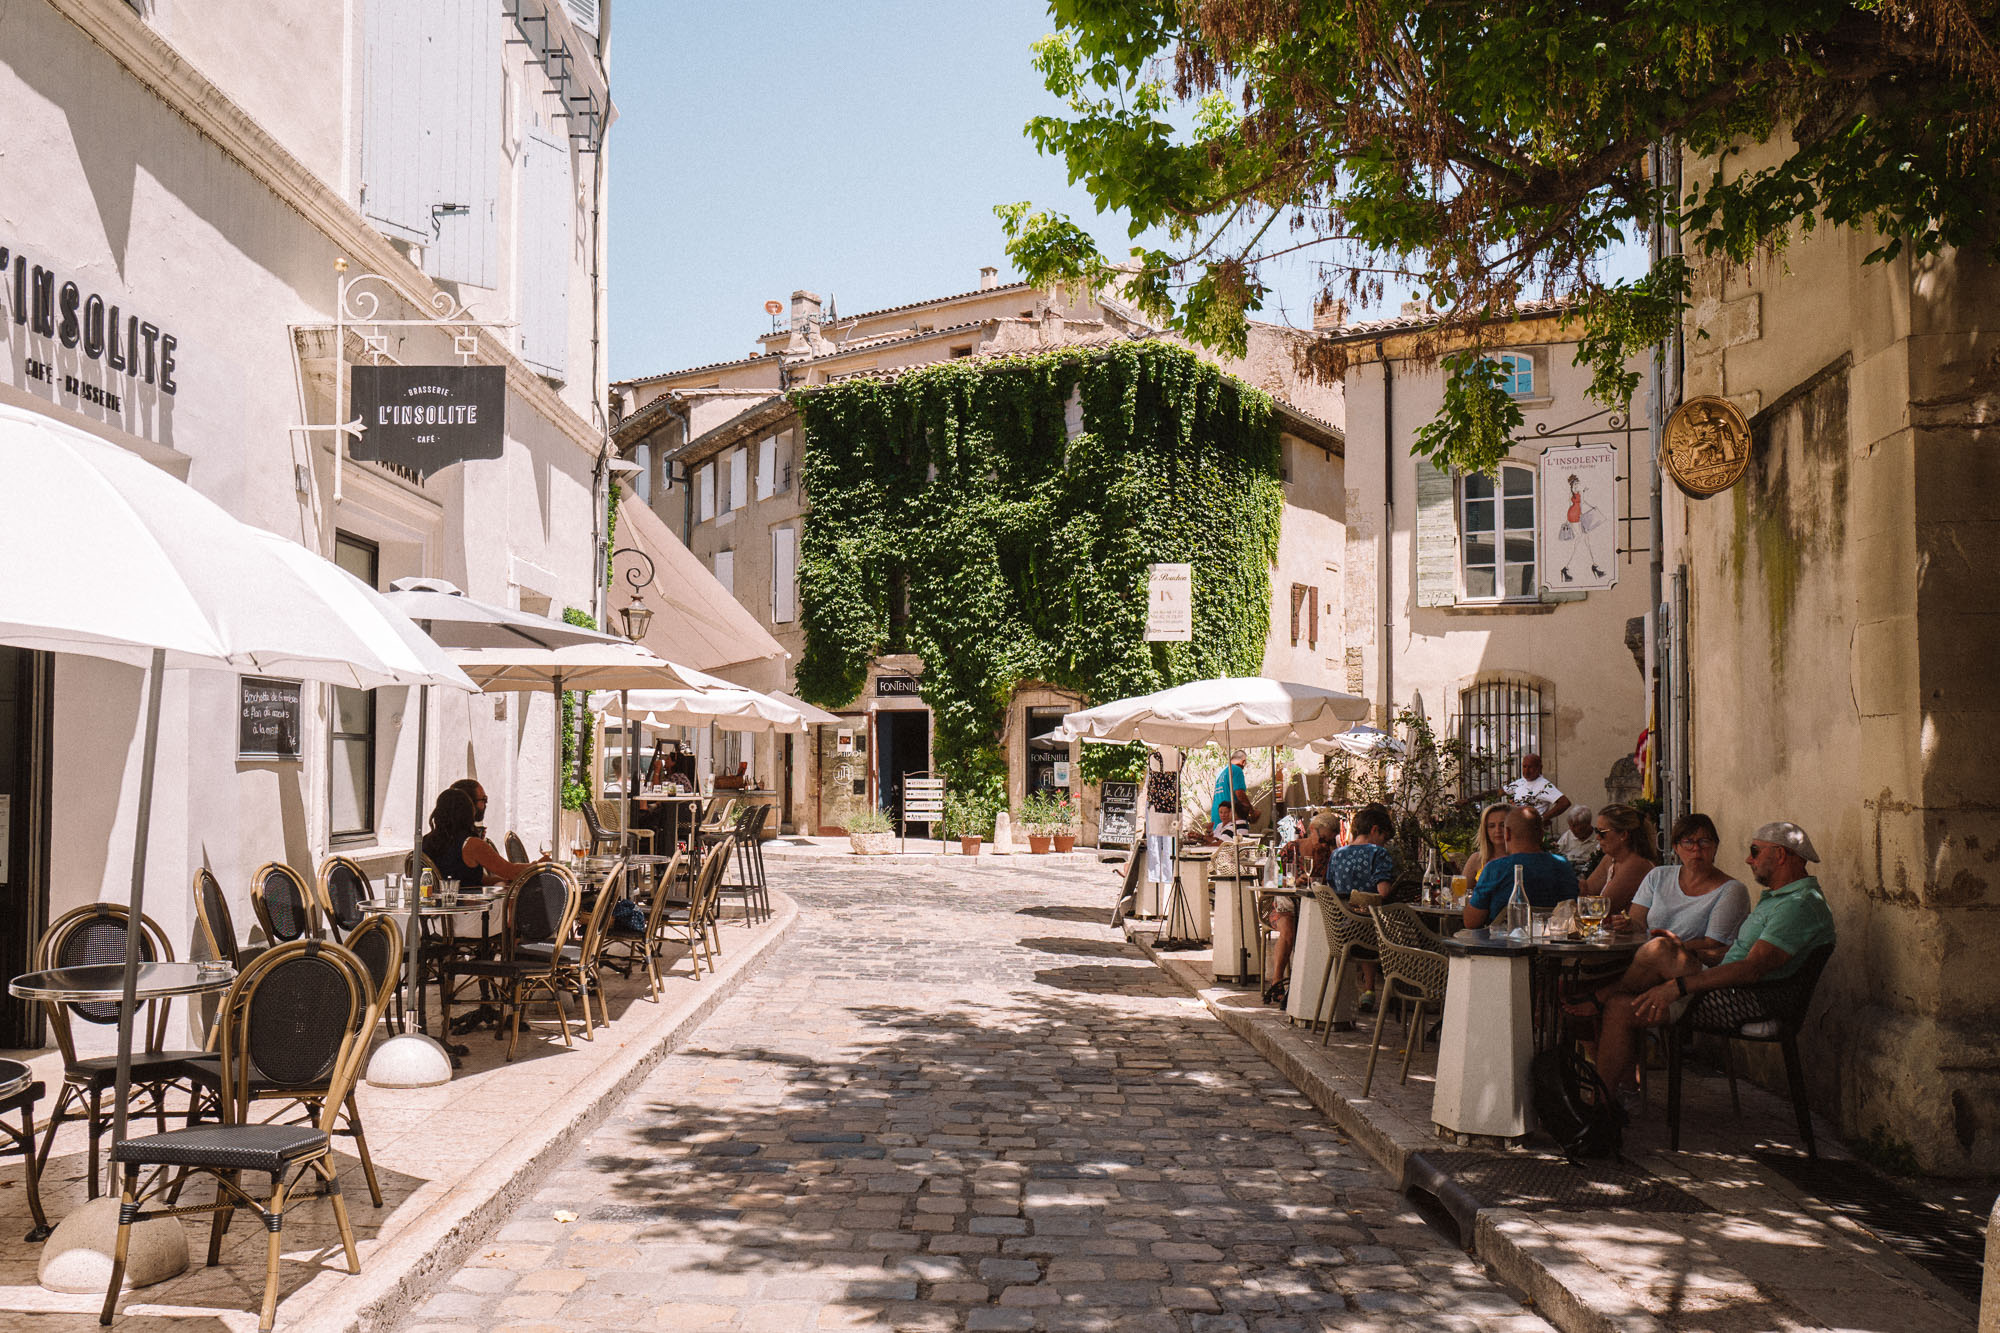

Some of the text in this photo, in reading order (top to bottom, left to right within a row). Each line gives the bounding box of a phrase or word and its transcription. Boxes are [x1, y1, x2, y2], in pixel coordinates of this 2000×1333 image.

[0, 246, 177, 395] 'INSOLITE
[25, 358, 52, 384] CAFÉ
[65, 375, 121, 412] BRASSERIE
[408, 385, 450, 397] BRASSERIE
[379, 405, 478, 425] L'INSOLITE
[417, 434, 435, 443] CAFÉ
[1547, 455, 1611, 466] L'INSOLENTE
[1031, 752, 1068, 762] FONTENILLE
